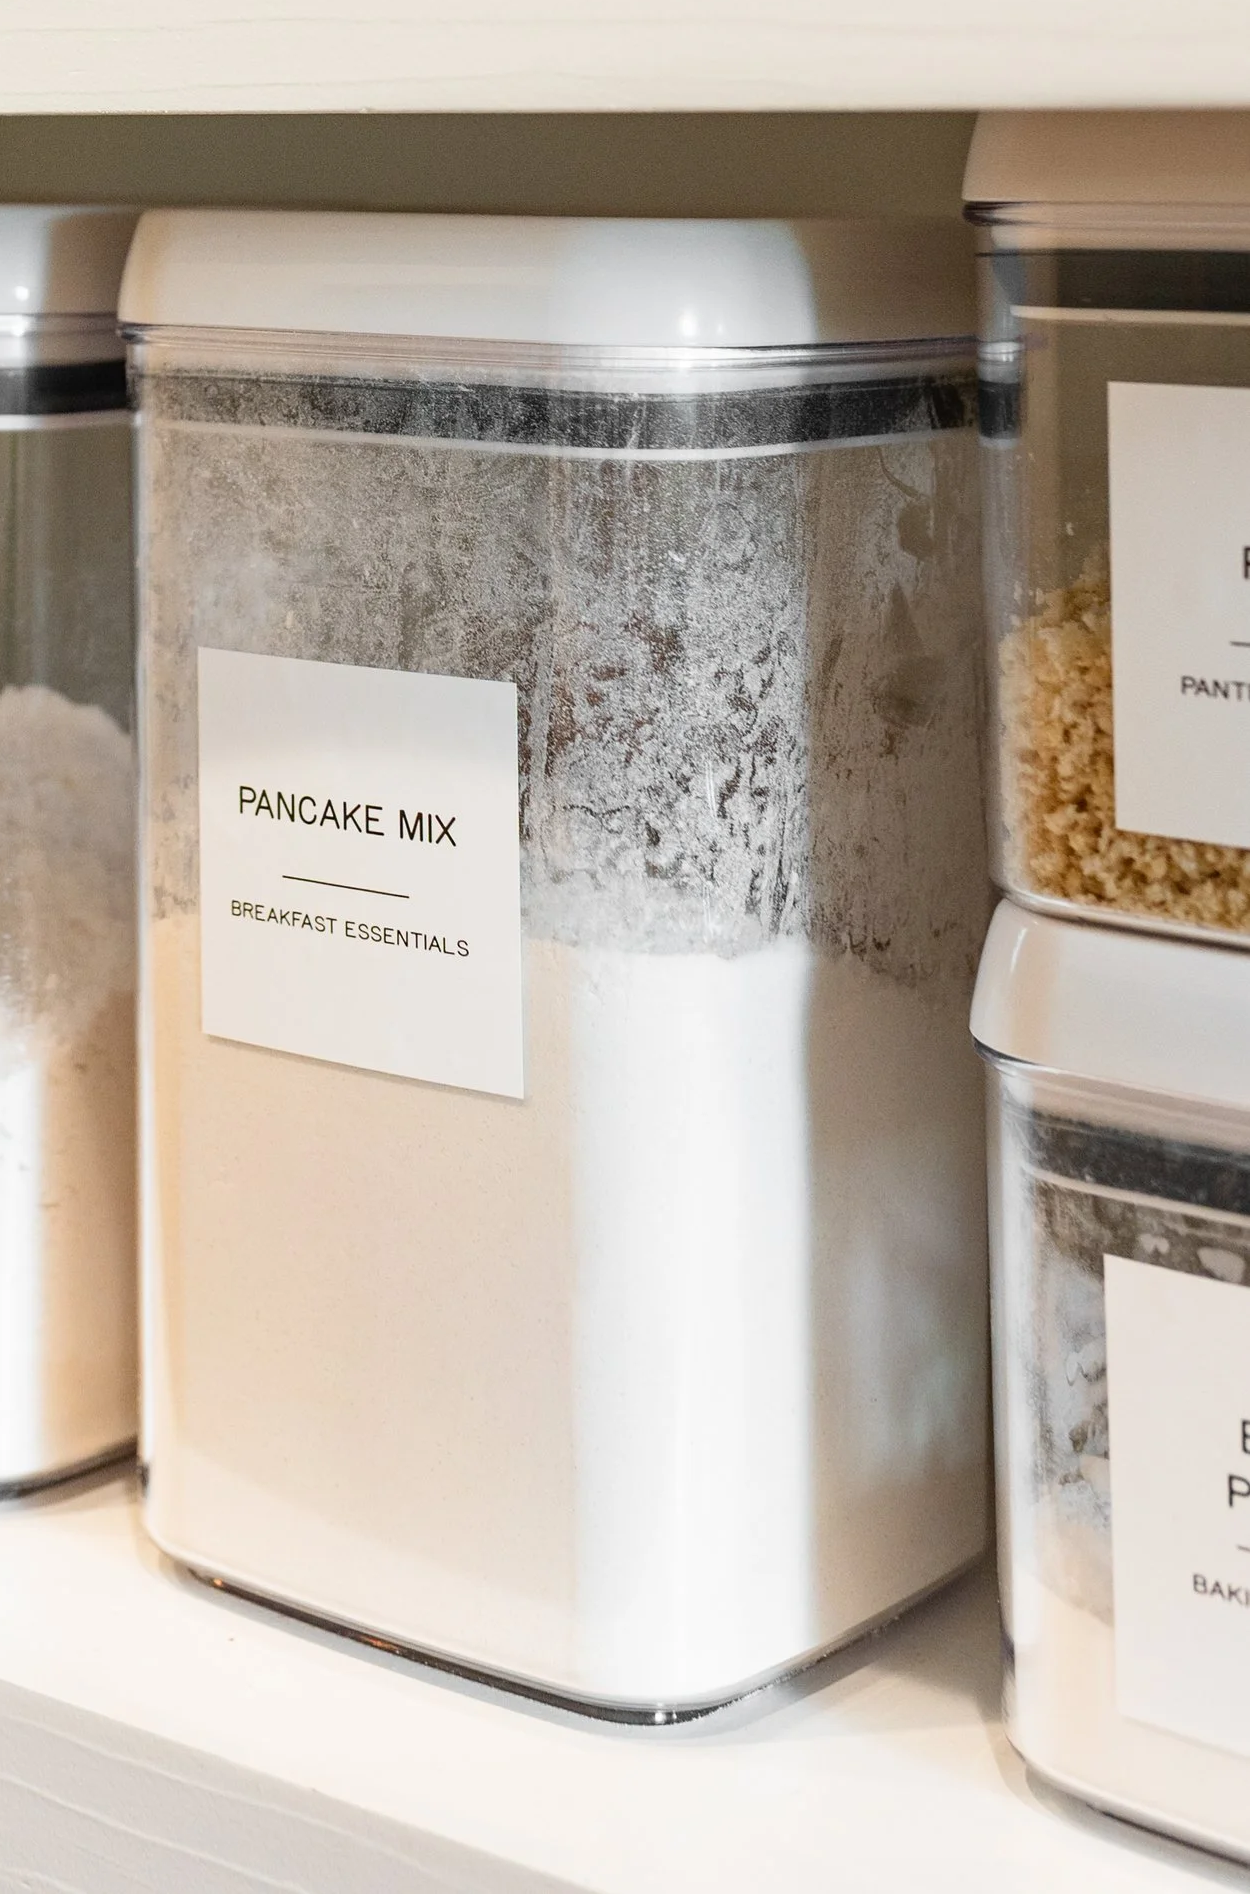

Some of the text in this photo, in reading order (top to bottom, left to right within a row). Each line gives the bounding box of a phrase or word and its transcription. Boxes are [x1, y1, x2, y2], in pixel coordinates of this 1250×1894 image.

[238, 785, 457, 847] PANCAKE MIX
[231, 900, 470, 958] BREAKFAST ESSENTIALS
